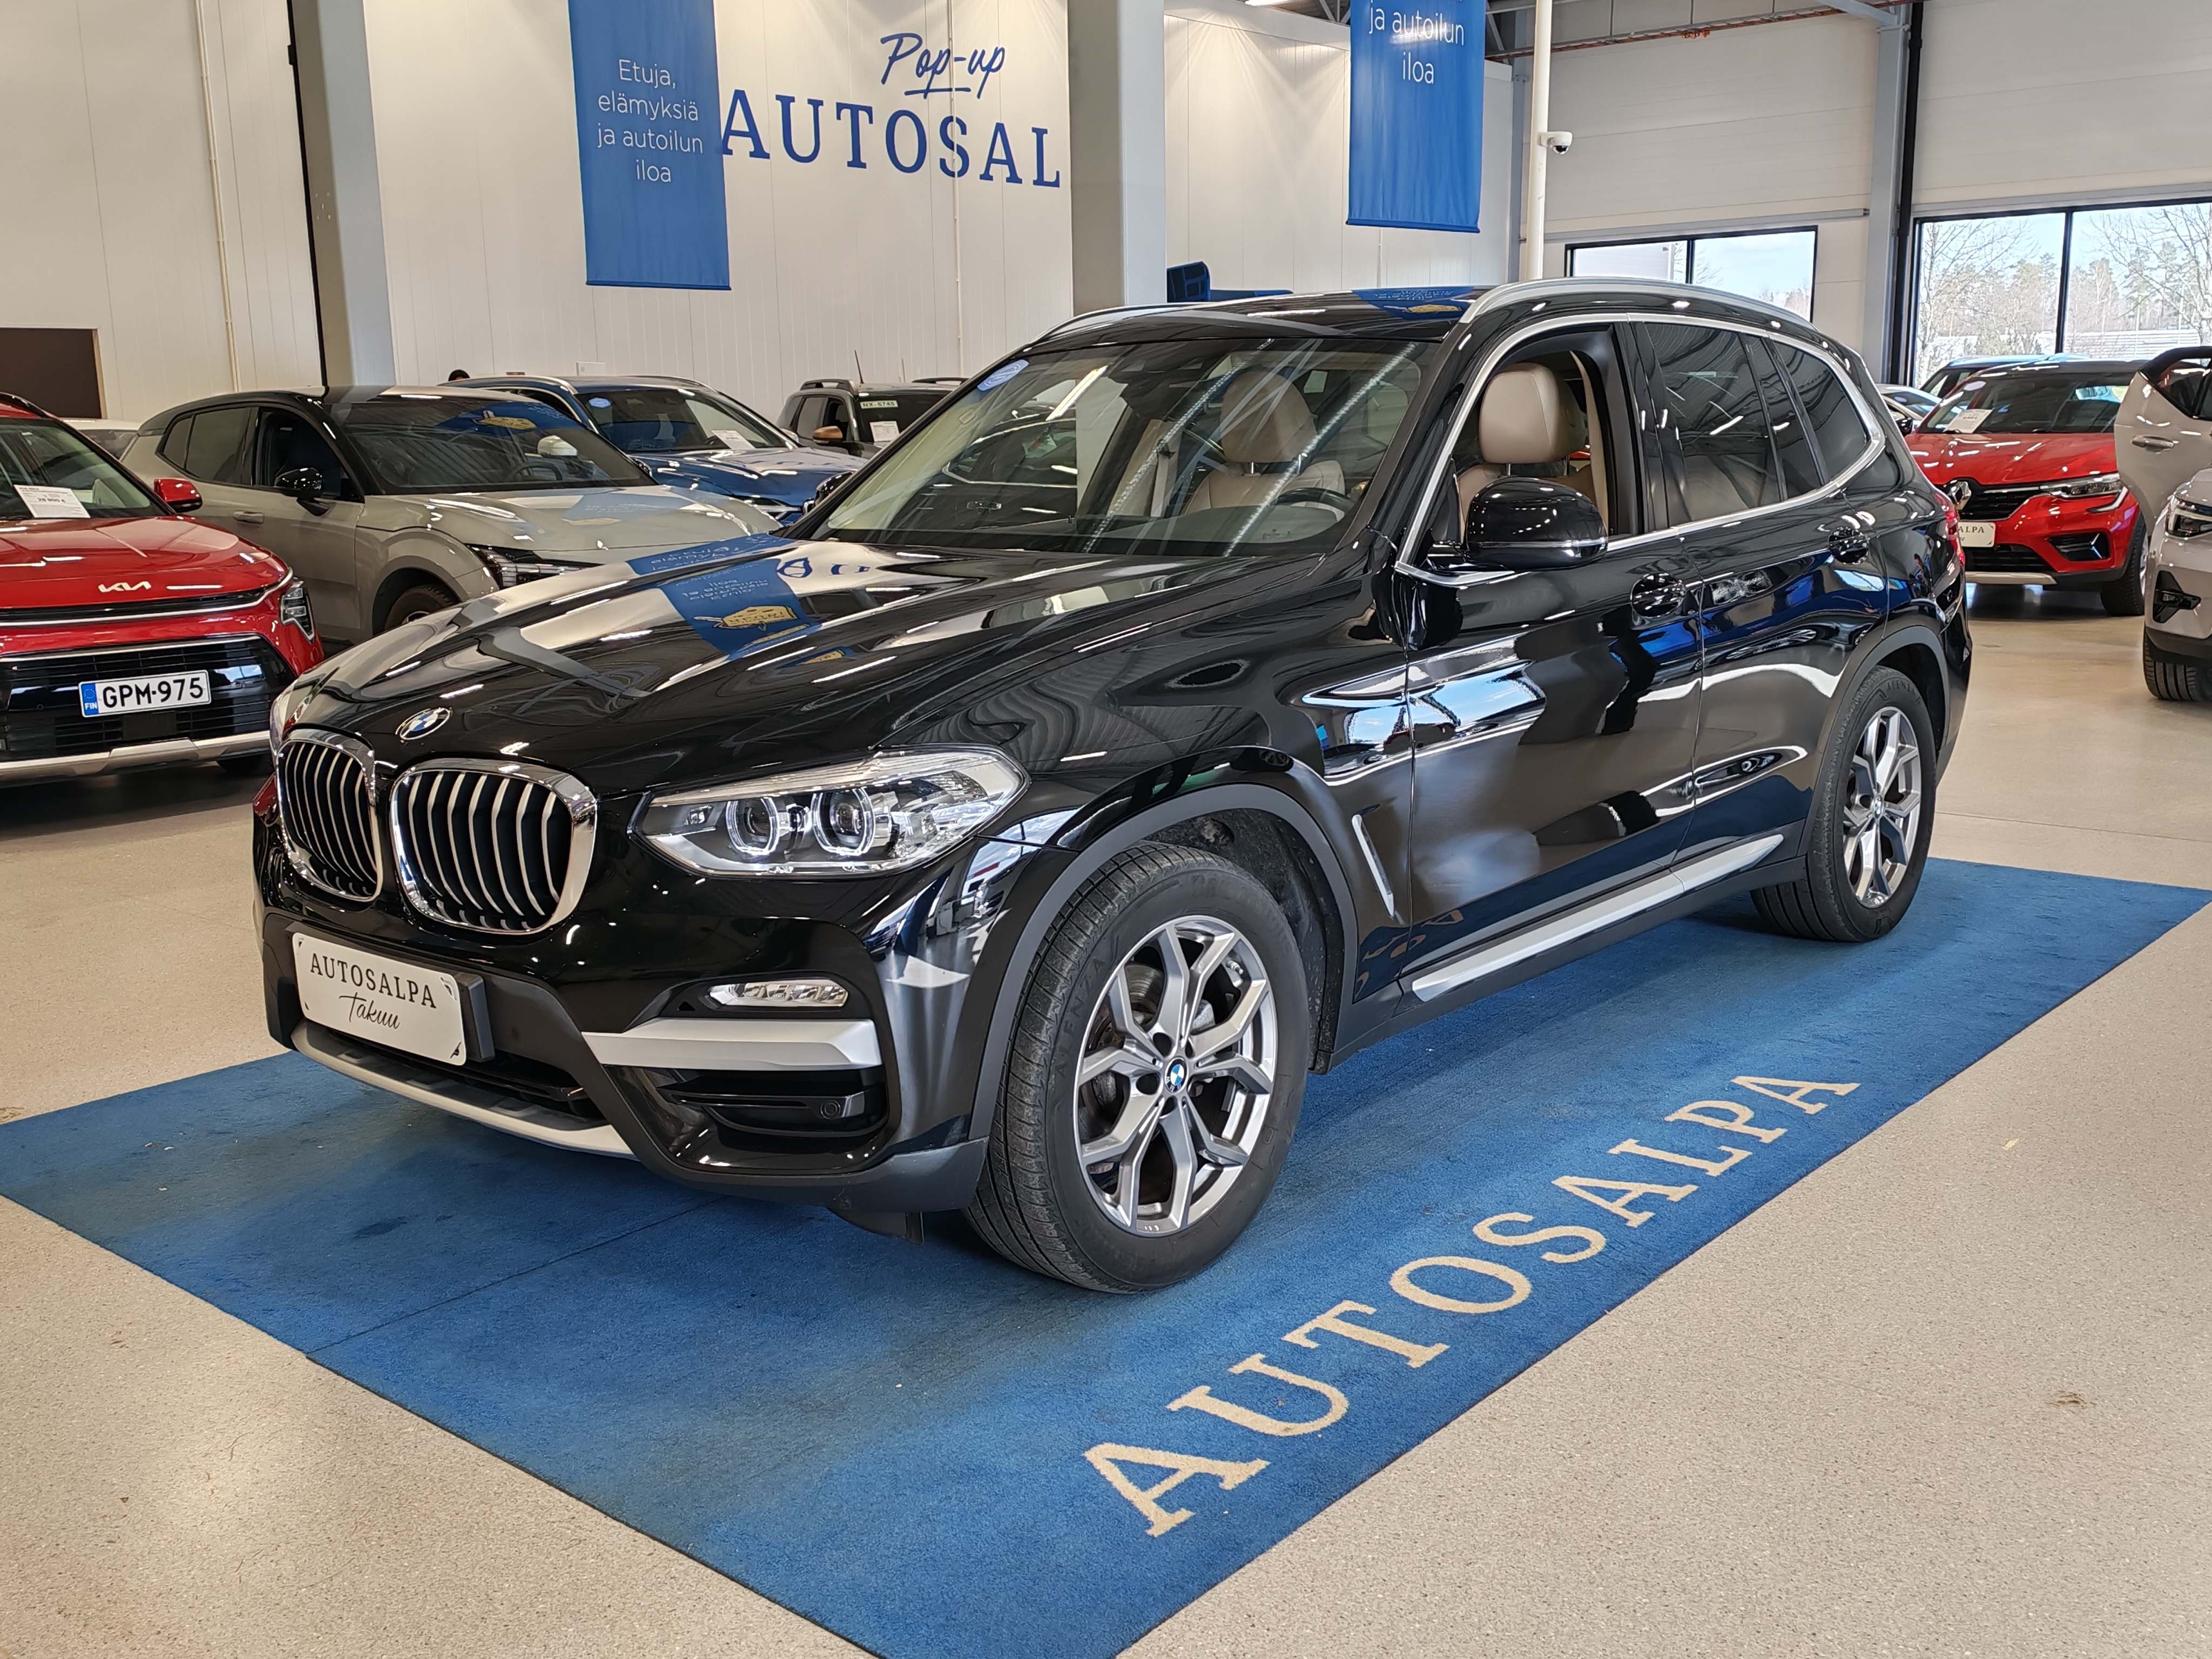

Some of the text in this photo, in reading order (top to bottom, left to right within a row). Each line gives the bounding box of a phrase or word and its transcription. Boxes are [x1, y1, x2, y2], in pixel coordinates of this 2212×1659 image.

[1368, 0, 1465, 46] ja autoilun
[618, 59, 676, 89] Etuja,
[880, 32, 1006, 100] Pop-up
[1402, 51, 1434, 84] iloa
[598, 90, 698, 122] elämyksiä
[597, 123, 703, 154] ja autoilun
[721, 89, 1061, 188] AUTOSAL
[635, 159, 672, 183] iloa
[98, 581, 152, 593] KIA
[84, 702, 98, 710] FIN
[103, 677, 204, 708] GPM-975
[310, 953, 437, 1009] AUTOSALPA
[339, 992, 401, 1030] Takuu
[1083, 1074, 1861, 1537] AUTOSALPA
